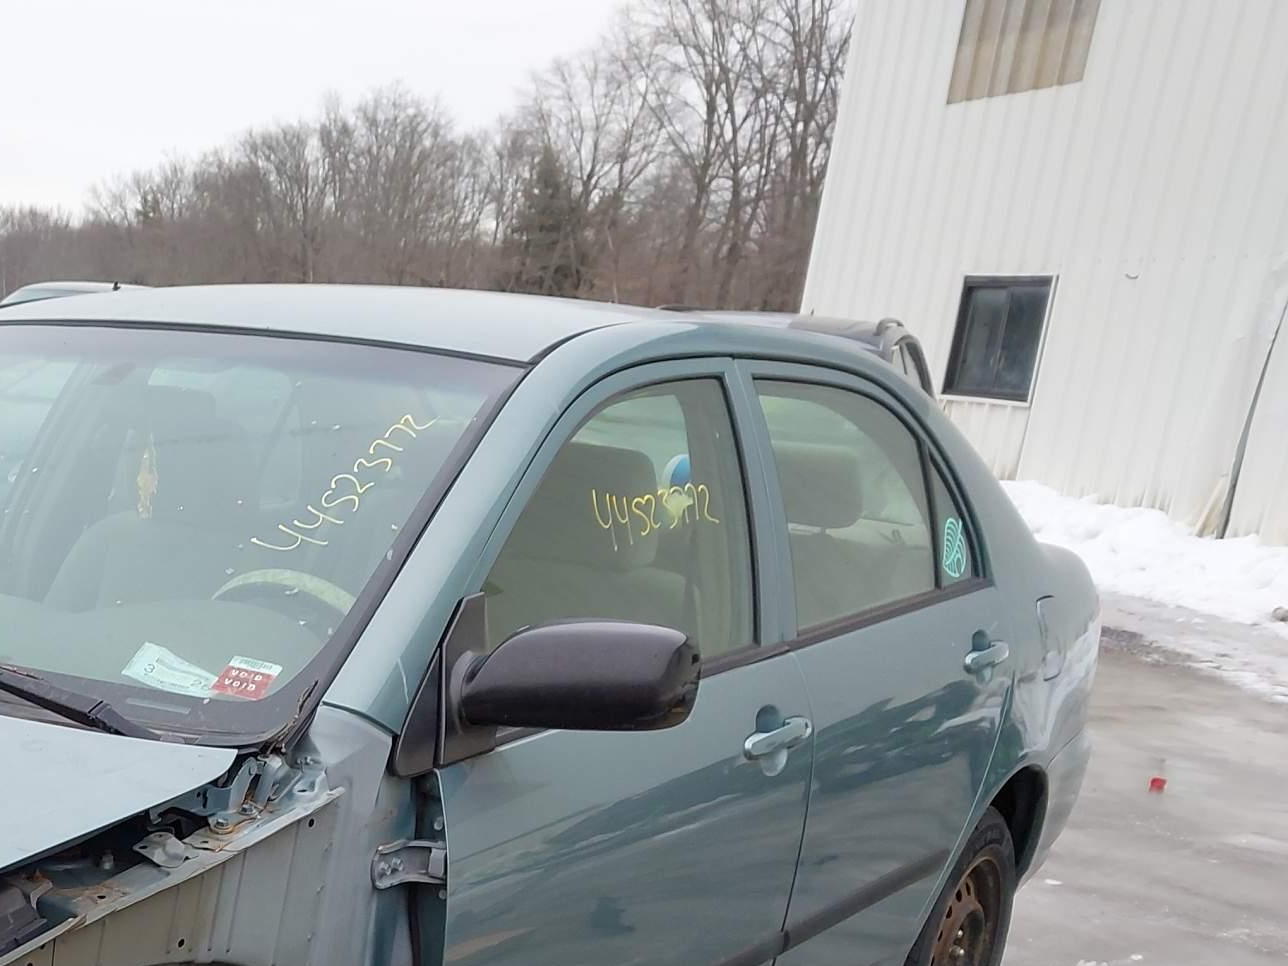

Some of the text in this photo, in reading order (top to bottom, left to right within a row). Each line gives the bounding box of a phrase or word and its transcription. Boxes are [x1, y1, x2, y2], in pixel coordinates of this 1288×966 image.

[250, 414, 440, 550] 44523772
[231, 668, 263, 682] VOID
[224, 677, 257, 692] VOID
